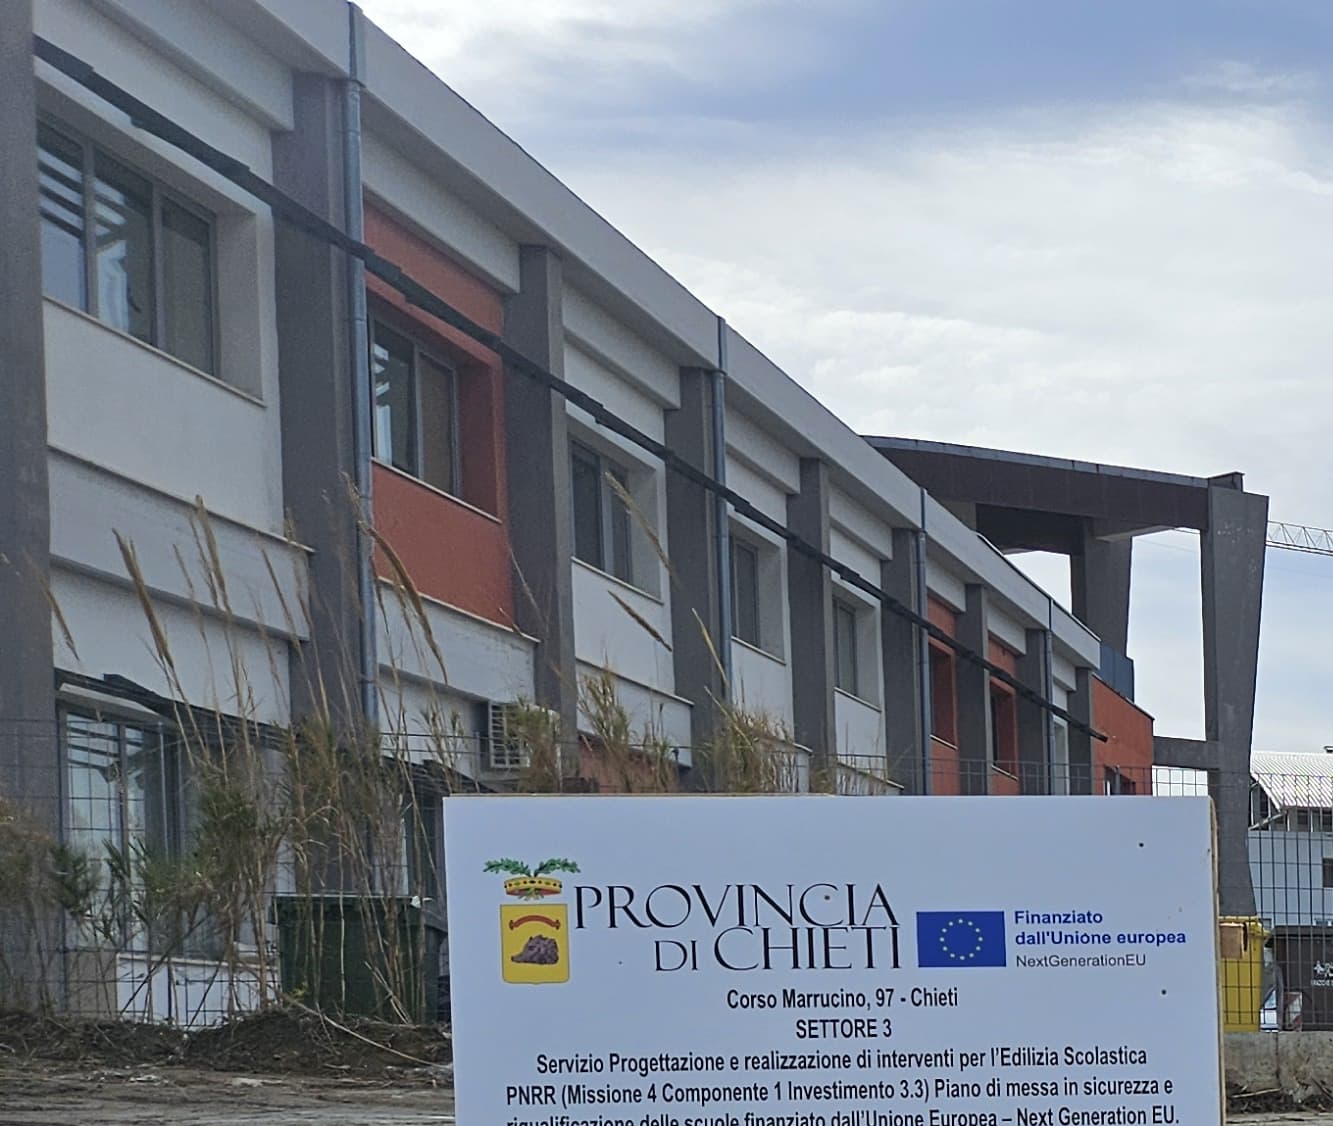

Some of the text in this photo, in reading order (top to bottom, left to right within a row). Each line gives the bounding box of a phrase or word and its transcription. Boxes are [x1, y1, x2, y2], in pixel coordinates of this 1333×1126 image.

[574, 883, 900, 929] PROVINCIA
[1014, 910, 1102, 924] Finanziato
[654, 925, 902, 971] DI CHIETI
[1116, 932, 1185, 946] europea
[1016, 953, 1145, 967] NextGenerationEU
[727, 989, 777, 1009] Corso
[782, 988, 870, 1010] Marrucino,
[875, 988, 894, 1007] 97
[910, 986, 957, 1006] Chieti
[796, 1018, 891, 1039] SETTORE 3
[536, 1053, 603, 1073] Servizio
[609, 1051, 724, 1077] Progettazione
[729, 1055, 738, 1070] e
[744, 1049, 851, 1070] realizzazione
[856, 1048, 871, 1068] di
[876, 1047, 953, 1068] interventi
[959, 1052, 986, 1072] per
[1064, 1045, 1146, 1065] Scolastica
[506, 1076, 1172, 1109] PNRR (Missione 4 Componente 1 Investimento 3.3) Piano di messa in sicurezza e
[1017, 1107, 1053, 1126] Next
[1058, 1105, 1146, 1126] Generation
[1152, 1104, 1179, 1124] EU.
